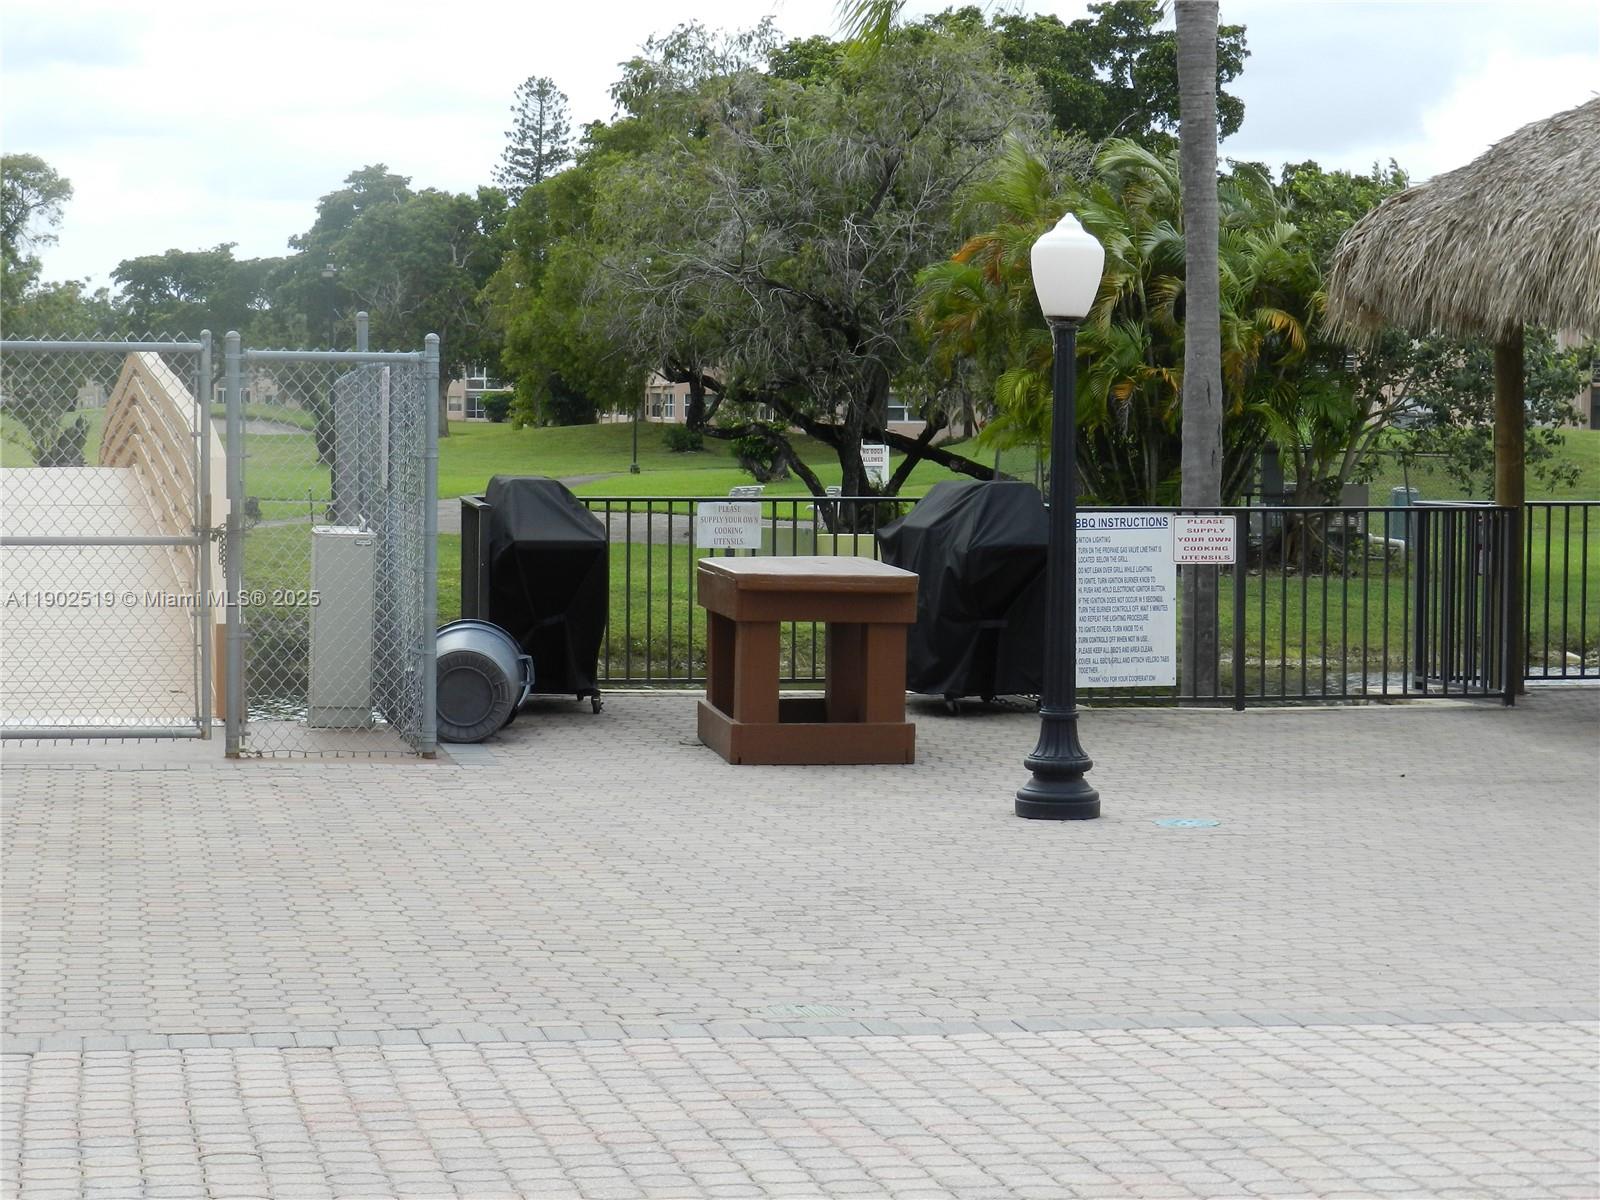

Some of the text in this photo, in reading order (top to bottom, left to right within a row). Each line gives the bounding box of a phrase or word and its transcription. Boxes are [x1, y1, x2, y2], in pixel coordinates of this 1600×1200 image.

[718, 505, 741, 513] PLEASE
[700, 516, 759, 524] SUPPLY YOUR OWN
[1076, 516, 1169, 528] BBQ INSTRUCTIONS
[714, 527, 743, 535] COOKING
[713, 537, 744, 545] UTENSILS
[1076, 536, 1091, 544] GNITION
